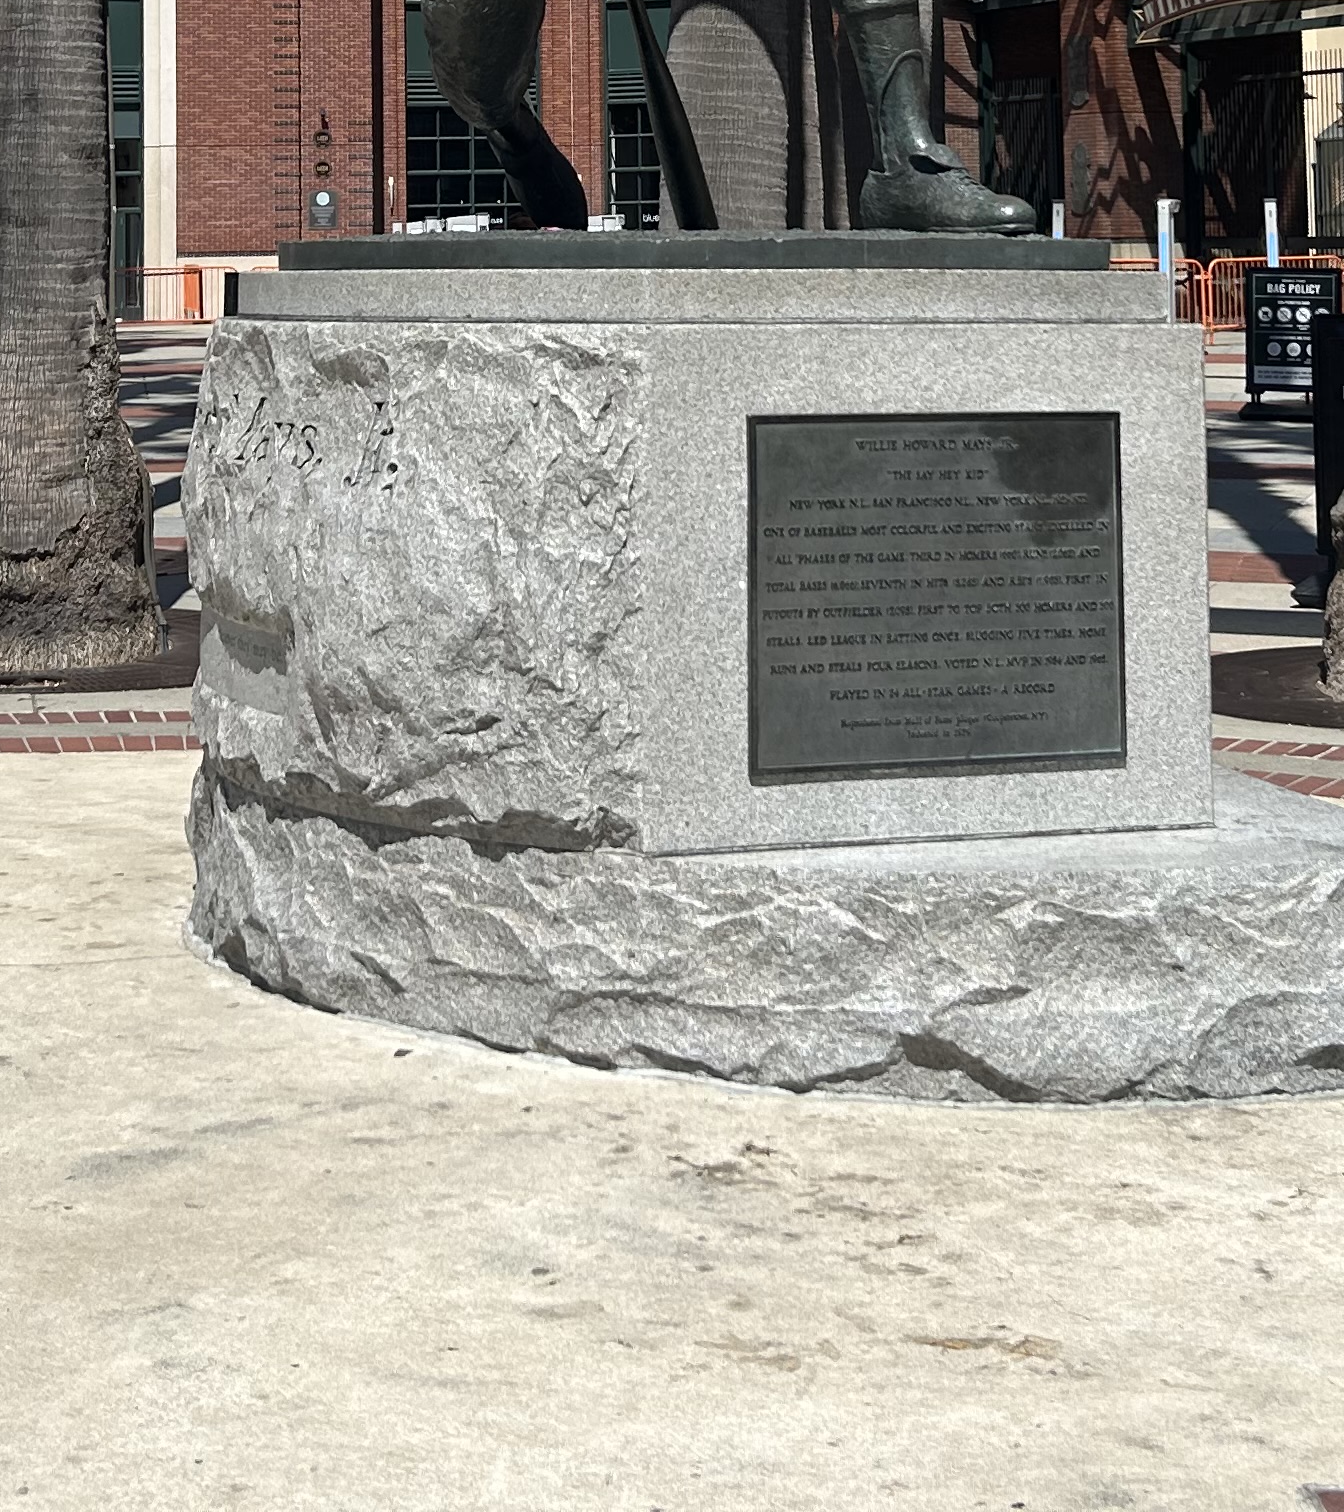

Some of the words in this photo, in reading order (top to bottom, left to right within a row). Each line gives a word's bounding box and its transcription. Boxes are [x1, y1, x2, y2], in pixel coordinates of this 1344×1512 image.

[1266, 283, 1286, 294] BAG
[1288, 284, 1322, 294] POLICY
[855, 439, 897, 452] WILLIE
[903, 439, 955, 452] HOWARD
[961, 438, 992, 451] MAYS
[916, 470, 933, 481] SAY
[939, 469, 960, 480] HEY
[790, 499, 812, 511] NEW
[817, 498, 845, 510] YORK
[873, 497, 892, 509] SAN
[896, 496, 952, 508] FRANCISCO
[976, 496, 998, 506] NEW
[764, 527, 784, 538] ONE
[788, 527, 800, 538] OF
[861, 525, 886, 536] MOST
[890, 524, 938, 535] COLORFUL
[941, 523, 962, 534] AND
[966, 522, 1010, 533] EXCITING
[775, 554, 792, 565] ALL
[797, 554, 835, 564] PHASES
[838, 553, 850, 564] OF
[855, 553, 873, 563] THE
[909, 551, 940, 562] THIRD
[944, 551, 954, 561] IN
[958, 550, 997, 560] HOMERS
[766, 582, 795, 593] TOTAL
[799, 581, 826, 591] BASES
[861, 579, 905, 590] SEVENTH
[910, 579, 921, 589] IN
[927, 577, 948, 587] HITS
[982, 576, 1004, 586] AND
[1066, 574, 1092, 584] FIRST
[1095, 573, 1108, 584] IN
[762, 609, 803, 620] PUTOUTS
[807, 608, 820, 619] BY
[823, 606, 882, 618] OUTFIELDER
[918, 605, 944, 616] FIRST
[947, 604, 960, 614] TO
[964, 604, 982, 614] TOP
[986, 603, 1011, 613] BOTH
[1033, 602, 1072, 613] HOMERS
[1075, 601, 1097, 611] AND
[807, 636, 827, 646] LED
[831, 635, 866, 646] LEAGUE
[869, 634, 882, 645] IN
[886, 633, 928, 644] BATTING
[965, 630, 1014, 641] SLUGGING
[1018, 629, 1040, 639] FIVE
[1078, 627, 1107, 637] HOME
[770, 664, 797, 675] RUNS
[800, 663, 824, 674] AND
[828, 662, 862, 673] STEALS
[867, 661, 892, 672] FOUR
[944, 658, 979, 669] VOTED
[1006, 656, 1028, 667] MVP
[1030, 655, 1043, 666] IN
[1064, 654, 1086, 665] AND
[830, 689, 869, 701] PLAYED
[873, 688, 885, 699] IN
[957, 685, 991, 696] GAMES
[1000, 684, 1008, 695] A
[1013, 683, 1055, 694] RECORD
